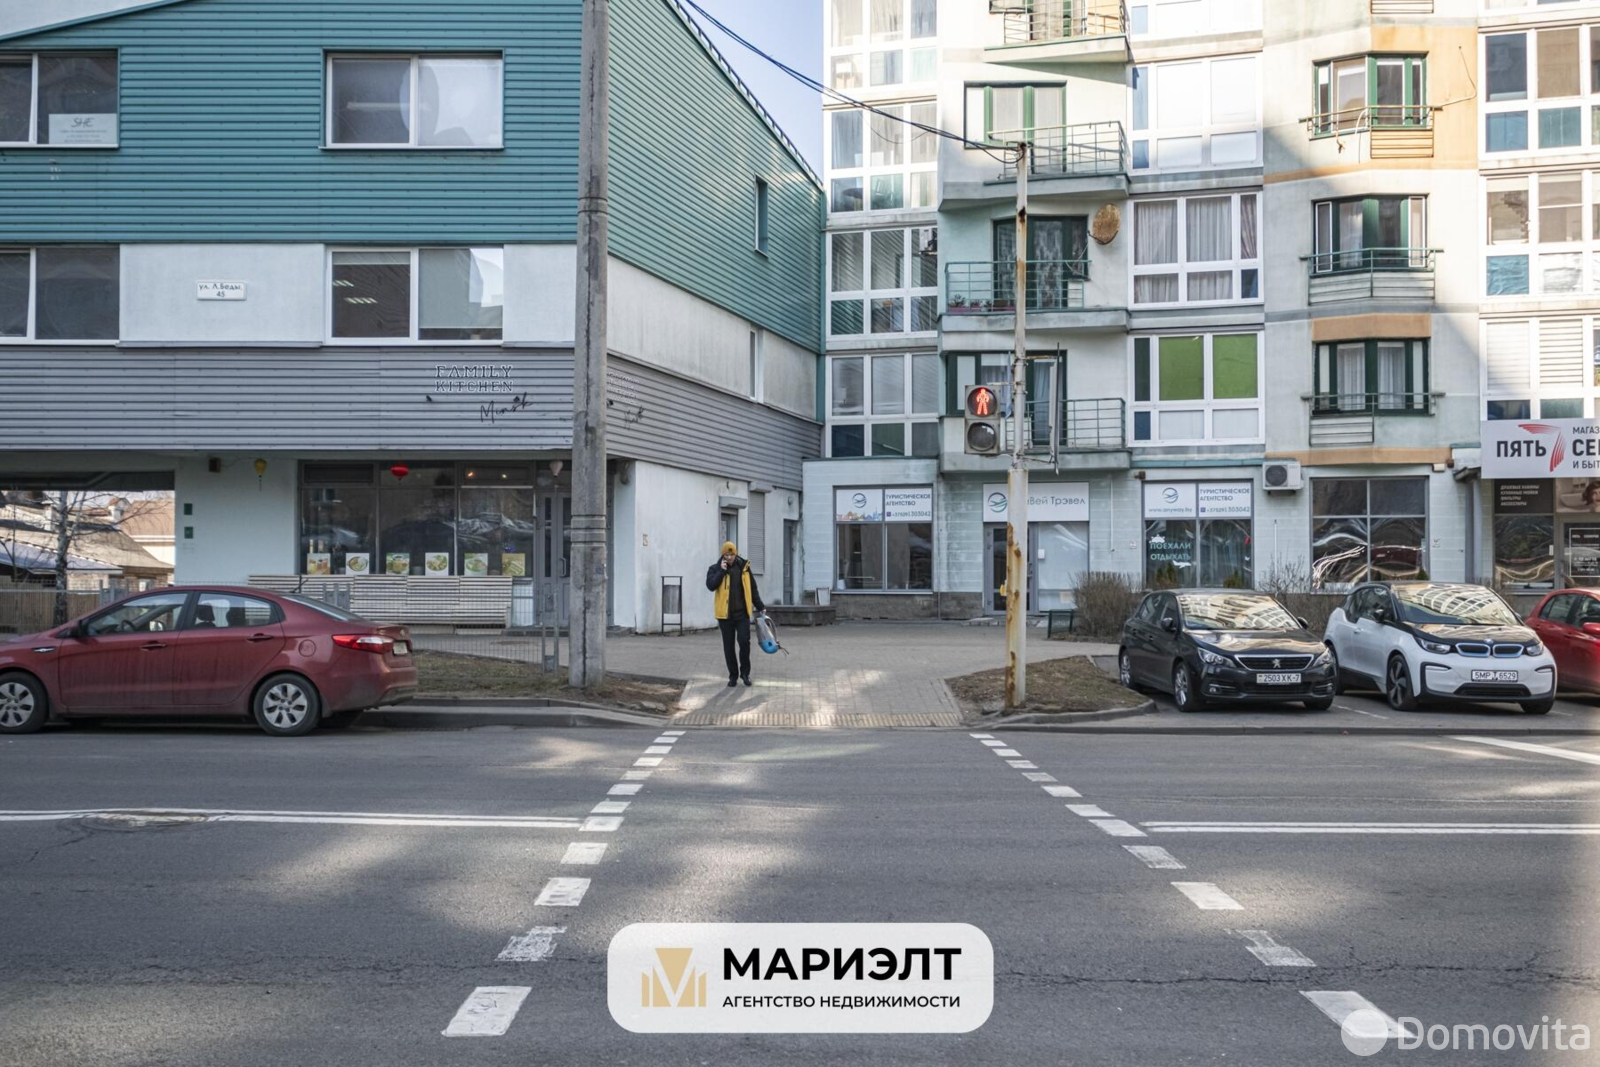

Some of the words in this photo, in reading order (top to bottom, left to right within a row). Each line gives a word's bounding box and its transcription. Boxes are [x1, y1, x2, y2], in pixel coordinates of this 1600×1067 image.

[435, 365, 513, 378] FAMILY
[435, 380, 514, 392] KITCHEN
[480, 392, 534, 424] Minsk
[1496, 440, 1547, 457] ПЯТЬ
[1572, 439, 1600, 456] СЕ
[1572, 461, 1580, 469] И
[1050, 496, 1086, 507] Трэвел
[1150, 553, 1191, 561] ОТДЫХАТЬ
[1264, 674, 1281, 682] 2503
